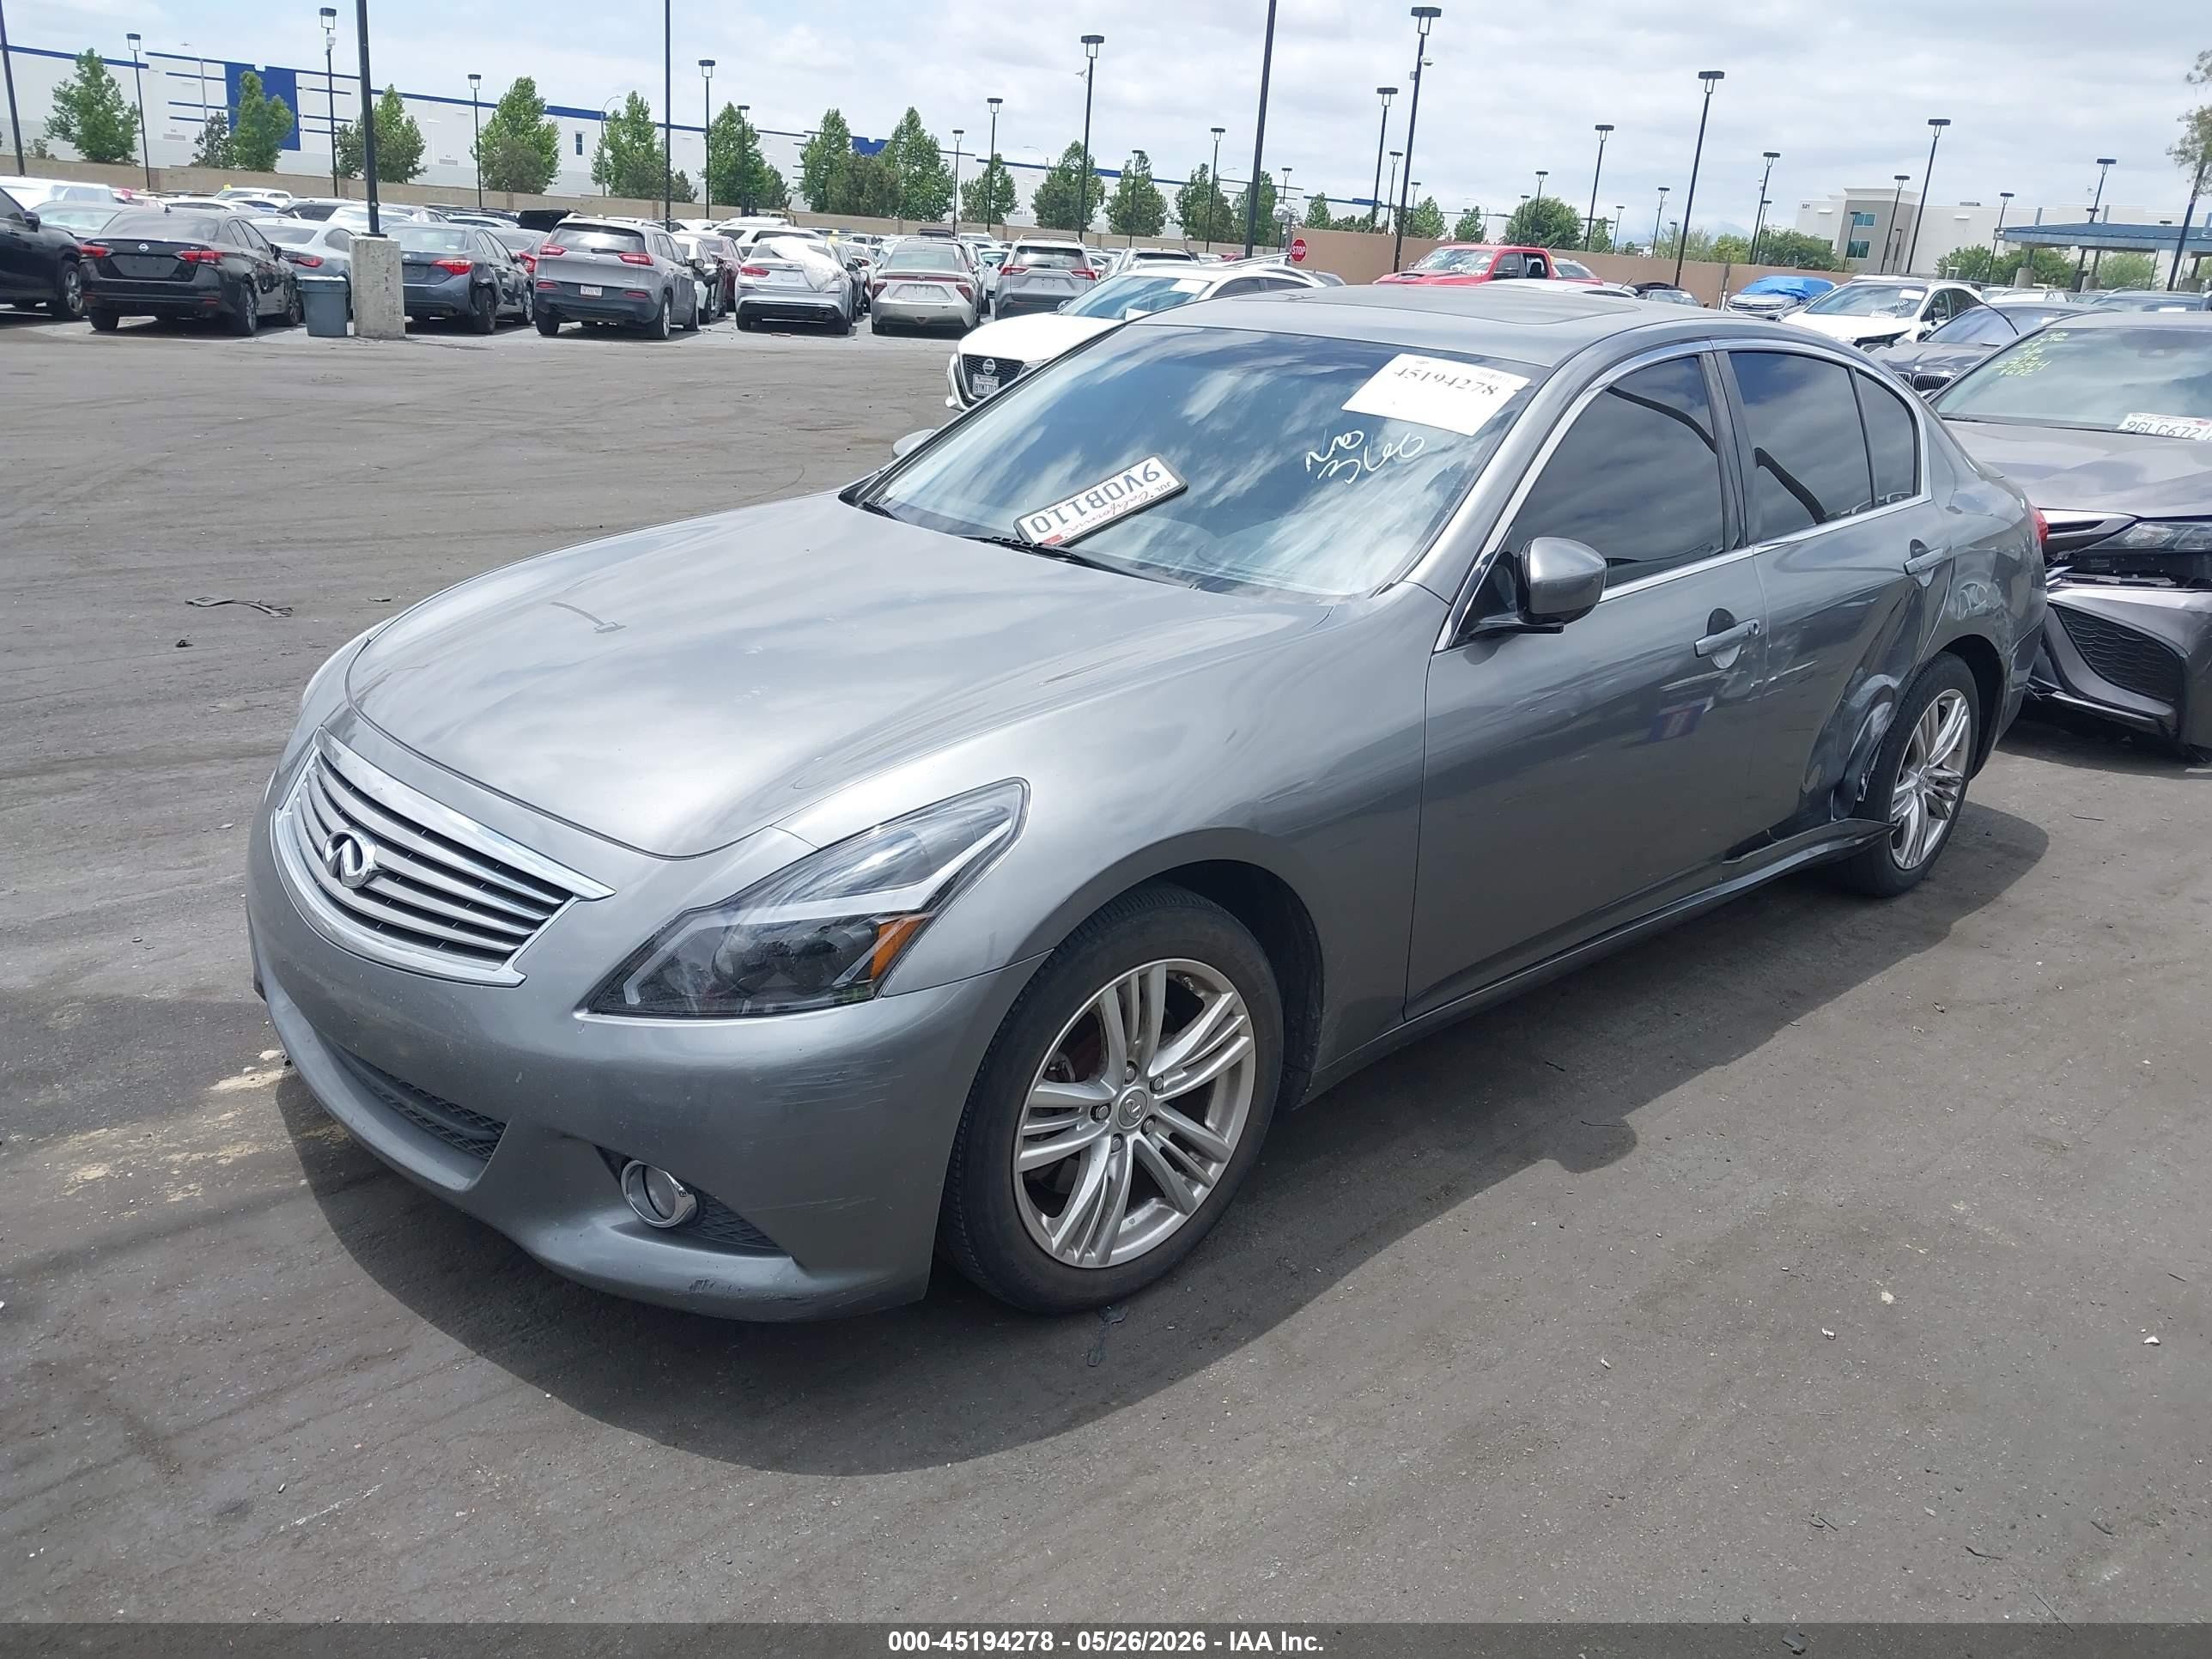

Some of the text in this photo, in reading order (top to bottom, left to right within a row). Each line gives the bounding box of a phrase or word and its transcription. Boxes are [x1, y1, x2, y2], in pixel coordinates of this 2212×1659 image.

[1291, 246, 1306, 256] STOP
[1394, 368, 1498, 397] 45194278
[1157, 481, 1171, 492] JUL
[1060, 490, 1149, 533] California
